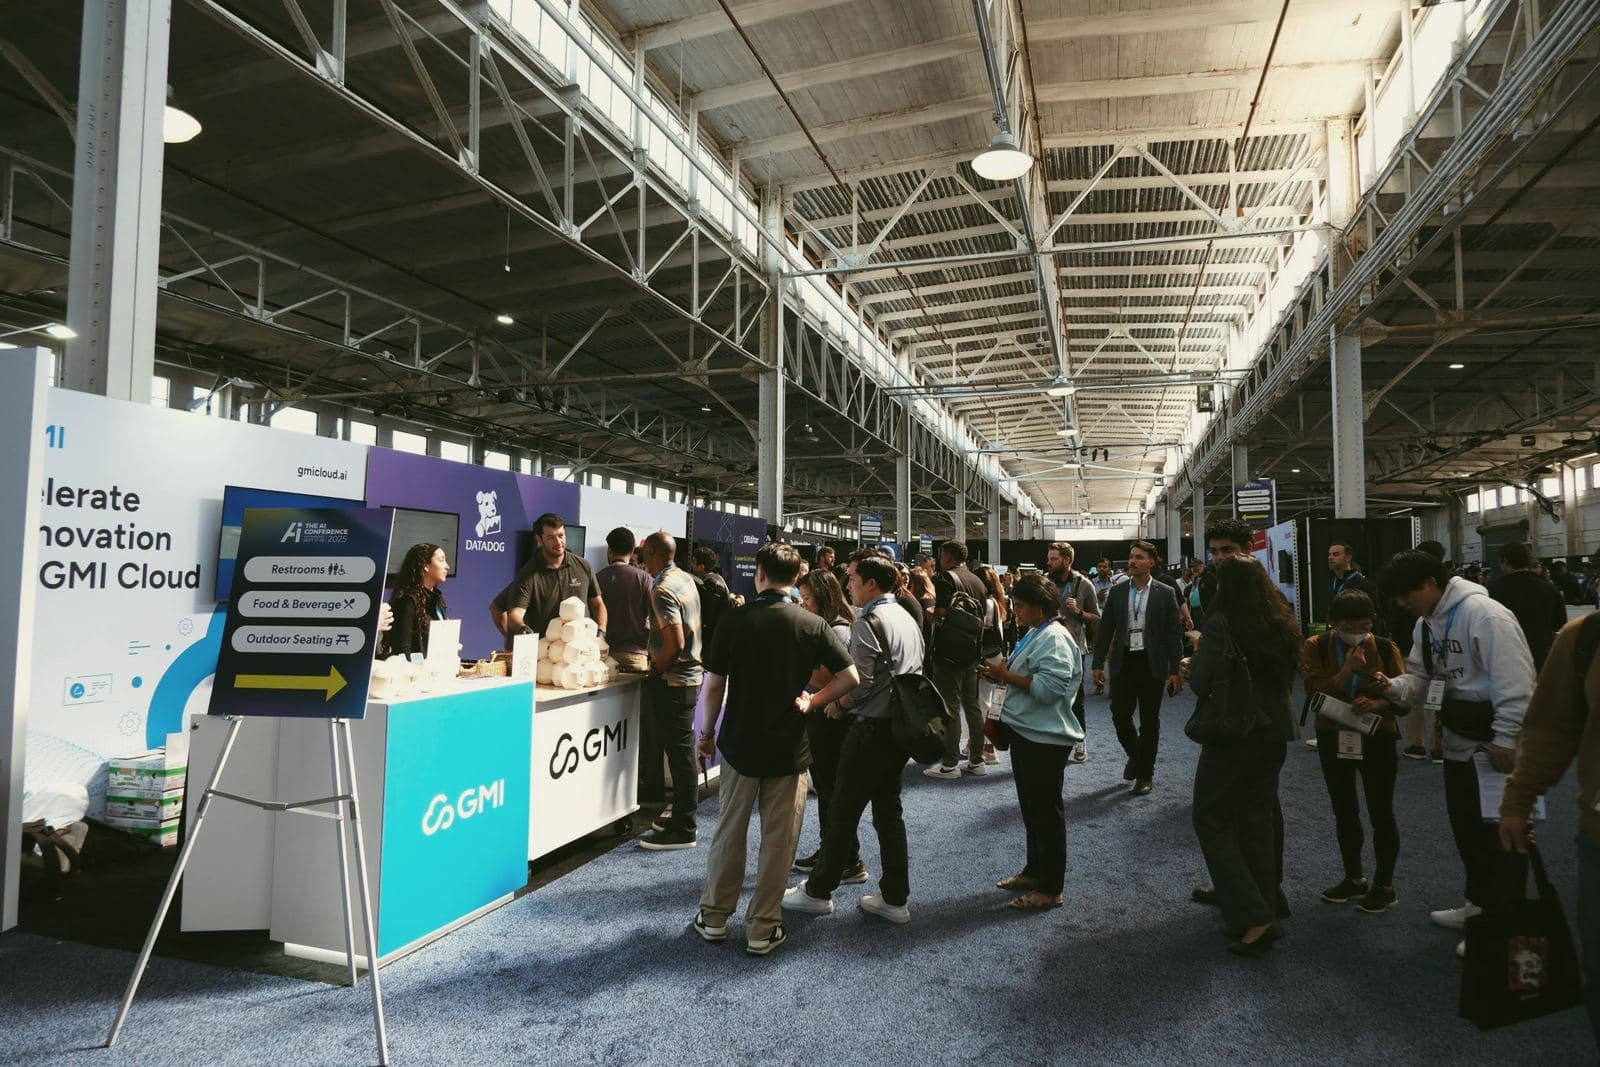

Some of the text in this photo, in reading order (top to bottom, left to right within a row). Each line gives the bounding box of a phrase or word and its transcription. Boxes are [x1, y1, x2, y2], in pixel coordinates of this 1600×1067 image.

[297, 466, 348, 480] gmicloud.ai
[42, 477, 140, 512] lerate
[327, 535, 348, 543] 2025
[465, 540, 505, 552] DATADOG
[39, 560, 201, 589] GMI Cloud
[271, 564, 325, 575] Restrooms
[253, 598, 342, 612] Food & Beverage
[246, 633, 333, 647] Outdoor Seating
[583, 718, 628, 762] GMI
[457, 778, 505, 820] GMI
